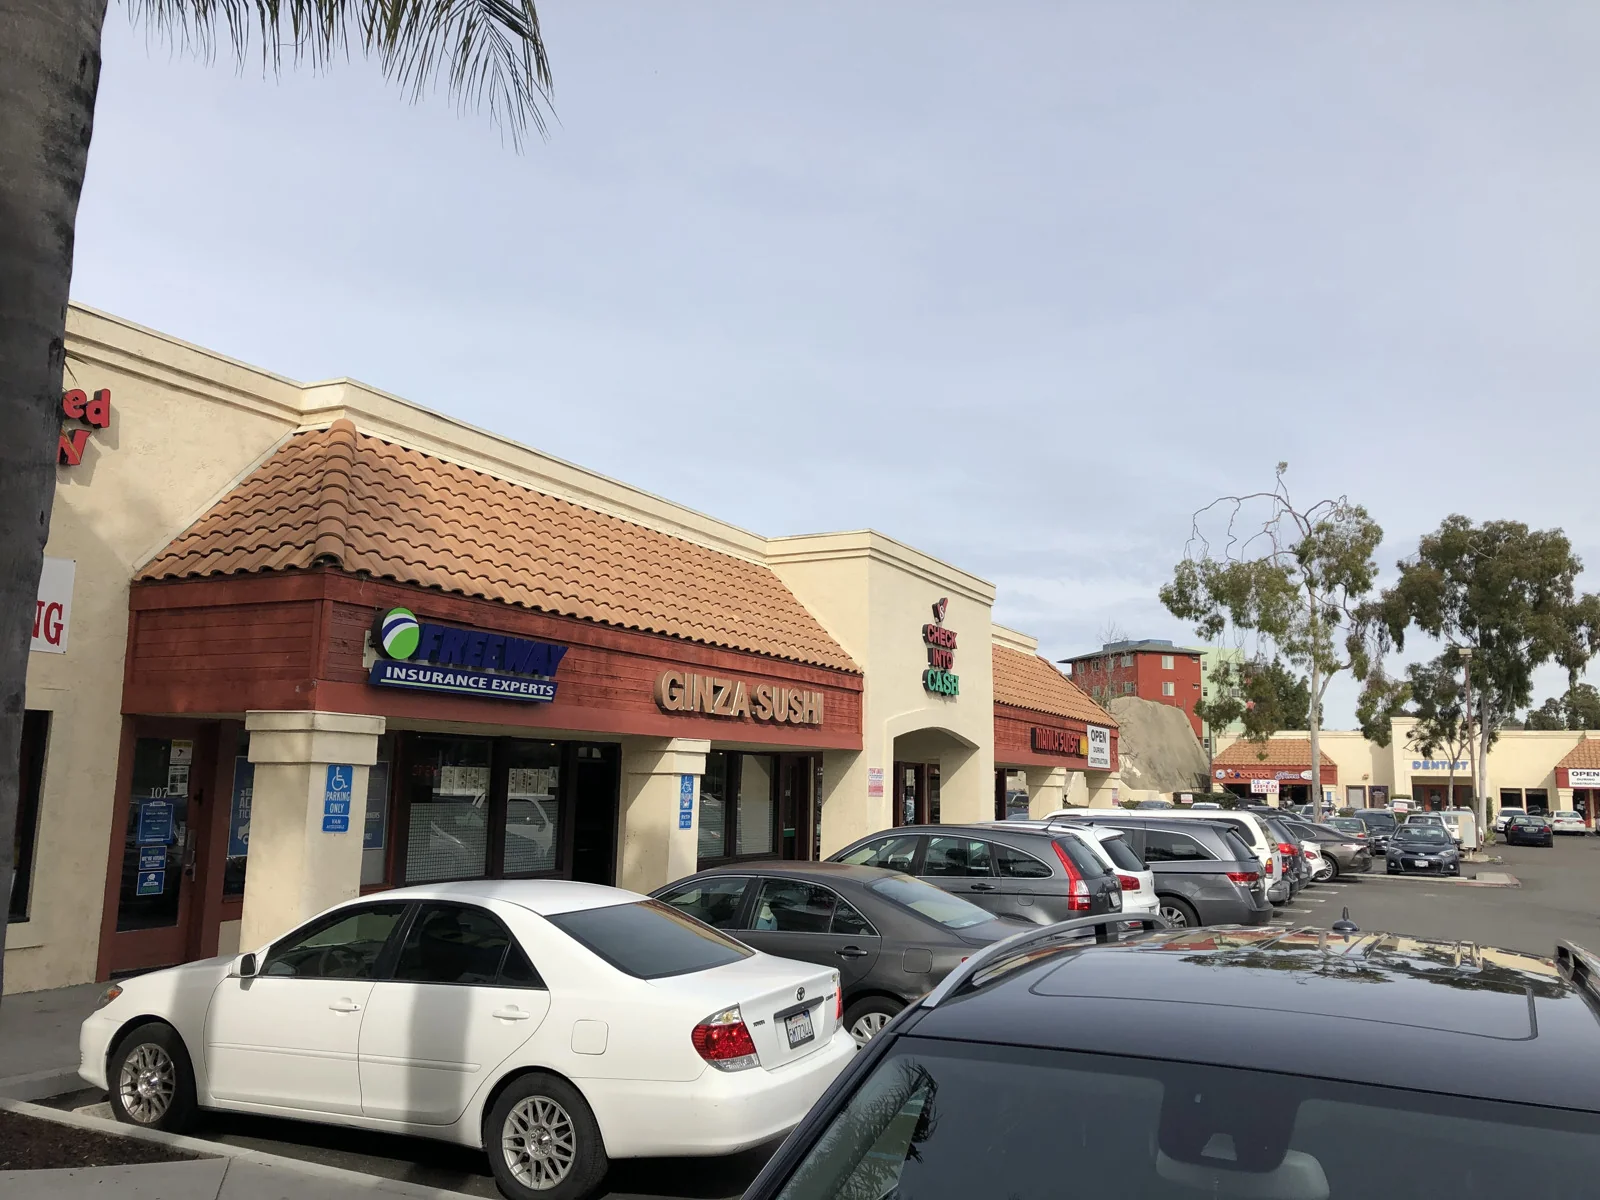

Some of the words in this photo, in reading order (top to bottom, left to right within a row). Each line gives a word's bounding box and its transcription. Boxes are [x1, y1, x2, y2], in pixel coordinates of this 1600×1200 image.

[63, 388, 111, 428] ed
[57, 429, 92, 465] N
[32, 600, 64, 646] NG
[926, 623, 957, 649] CHECK
[414, 623, 569, 677] FREEWAY
[931, 647, 953, 669] INTO
[386, 666, 487, 690] INSURANCE
[491, 679, 554, 696] EXPERTS
[657, 670, 750, 718] GINZA
[755, 684, 824, 725] SUSHI
[1091, 729, 1107, 743] OPEN
[1093, 746, 1105, 754] DURING
[1412, 760, 1468, 770] DENTIST
[150, 787, 168, 798] 107
[326, 791, 350, 801] PARKING
[330, 803, 344, 813] ONLY
